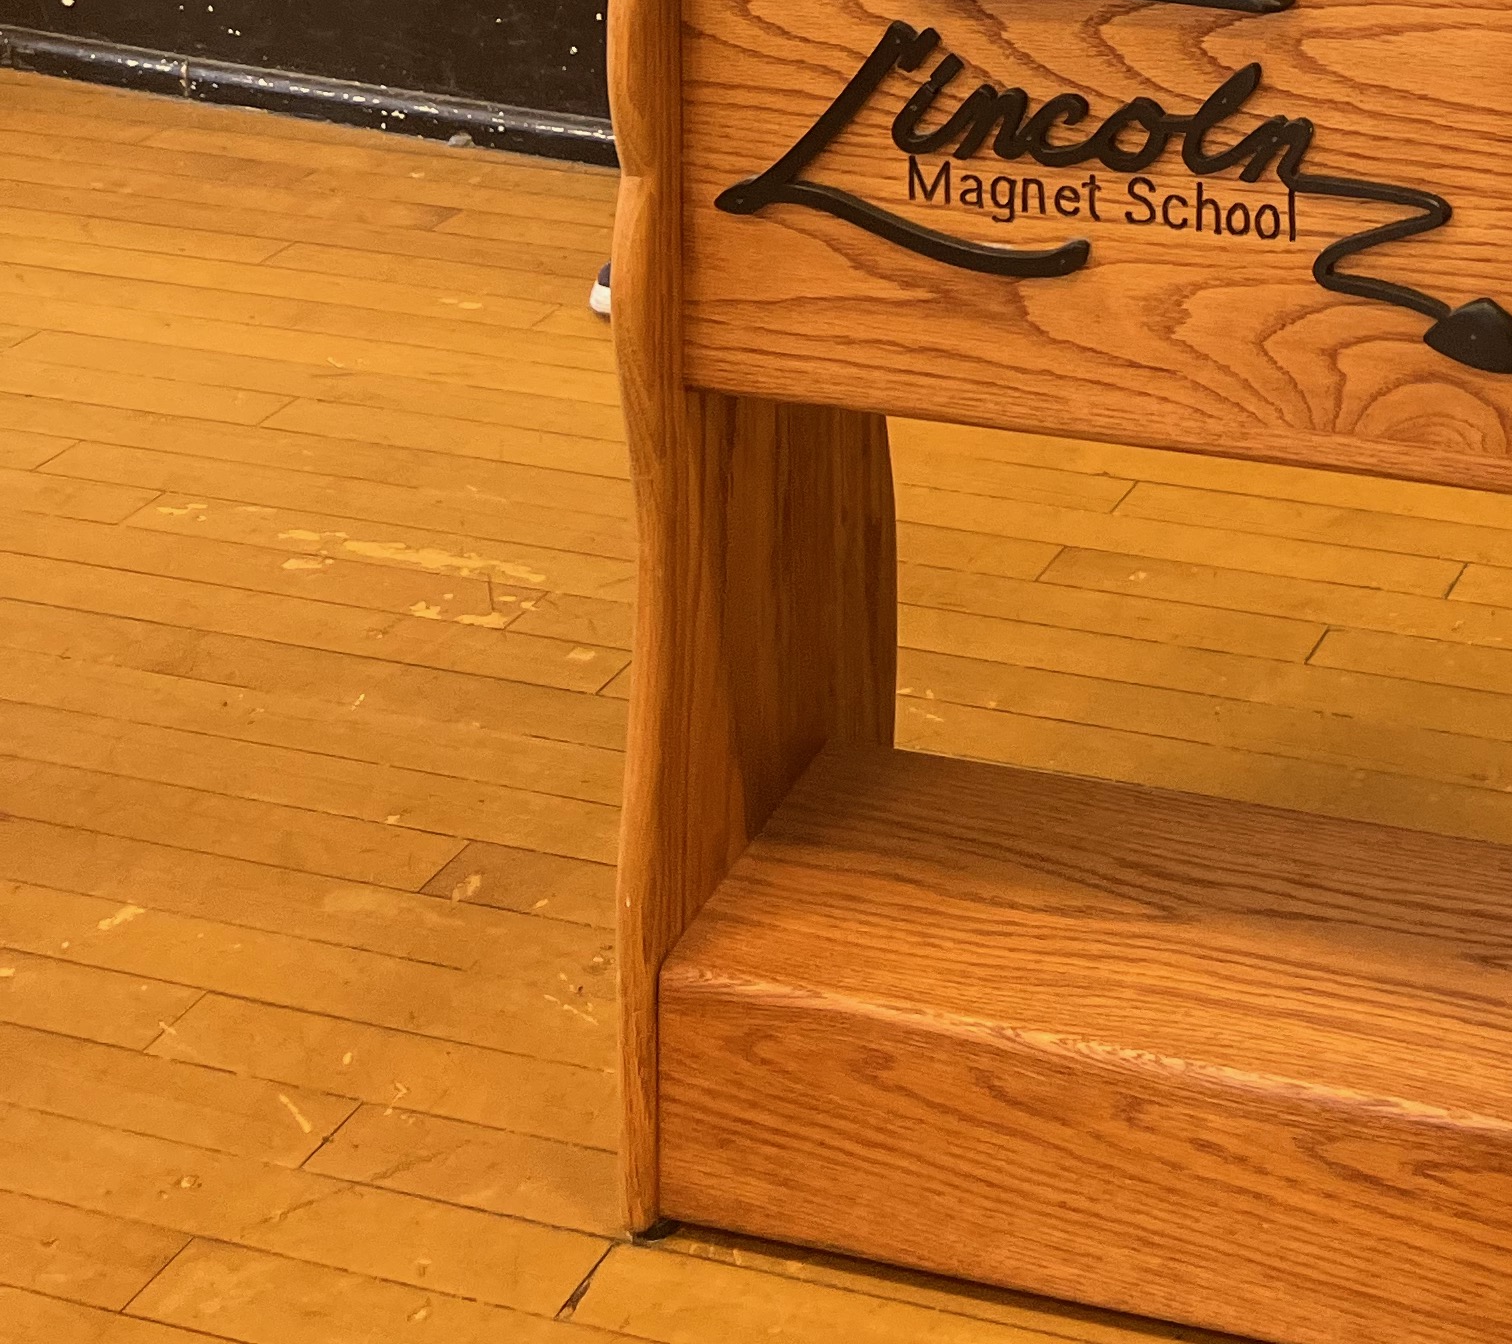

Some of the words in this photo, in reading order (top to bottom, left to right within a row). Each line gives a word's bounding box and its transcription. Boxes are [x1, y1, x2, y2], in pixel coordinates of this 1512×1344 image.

[713, 19, 1317, 278] Lincoln
[906, 155, 1101, 223] Magnet
[1124, 176, 1298, 243] School
